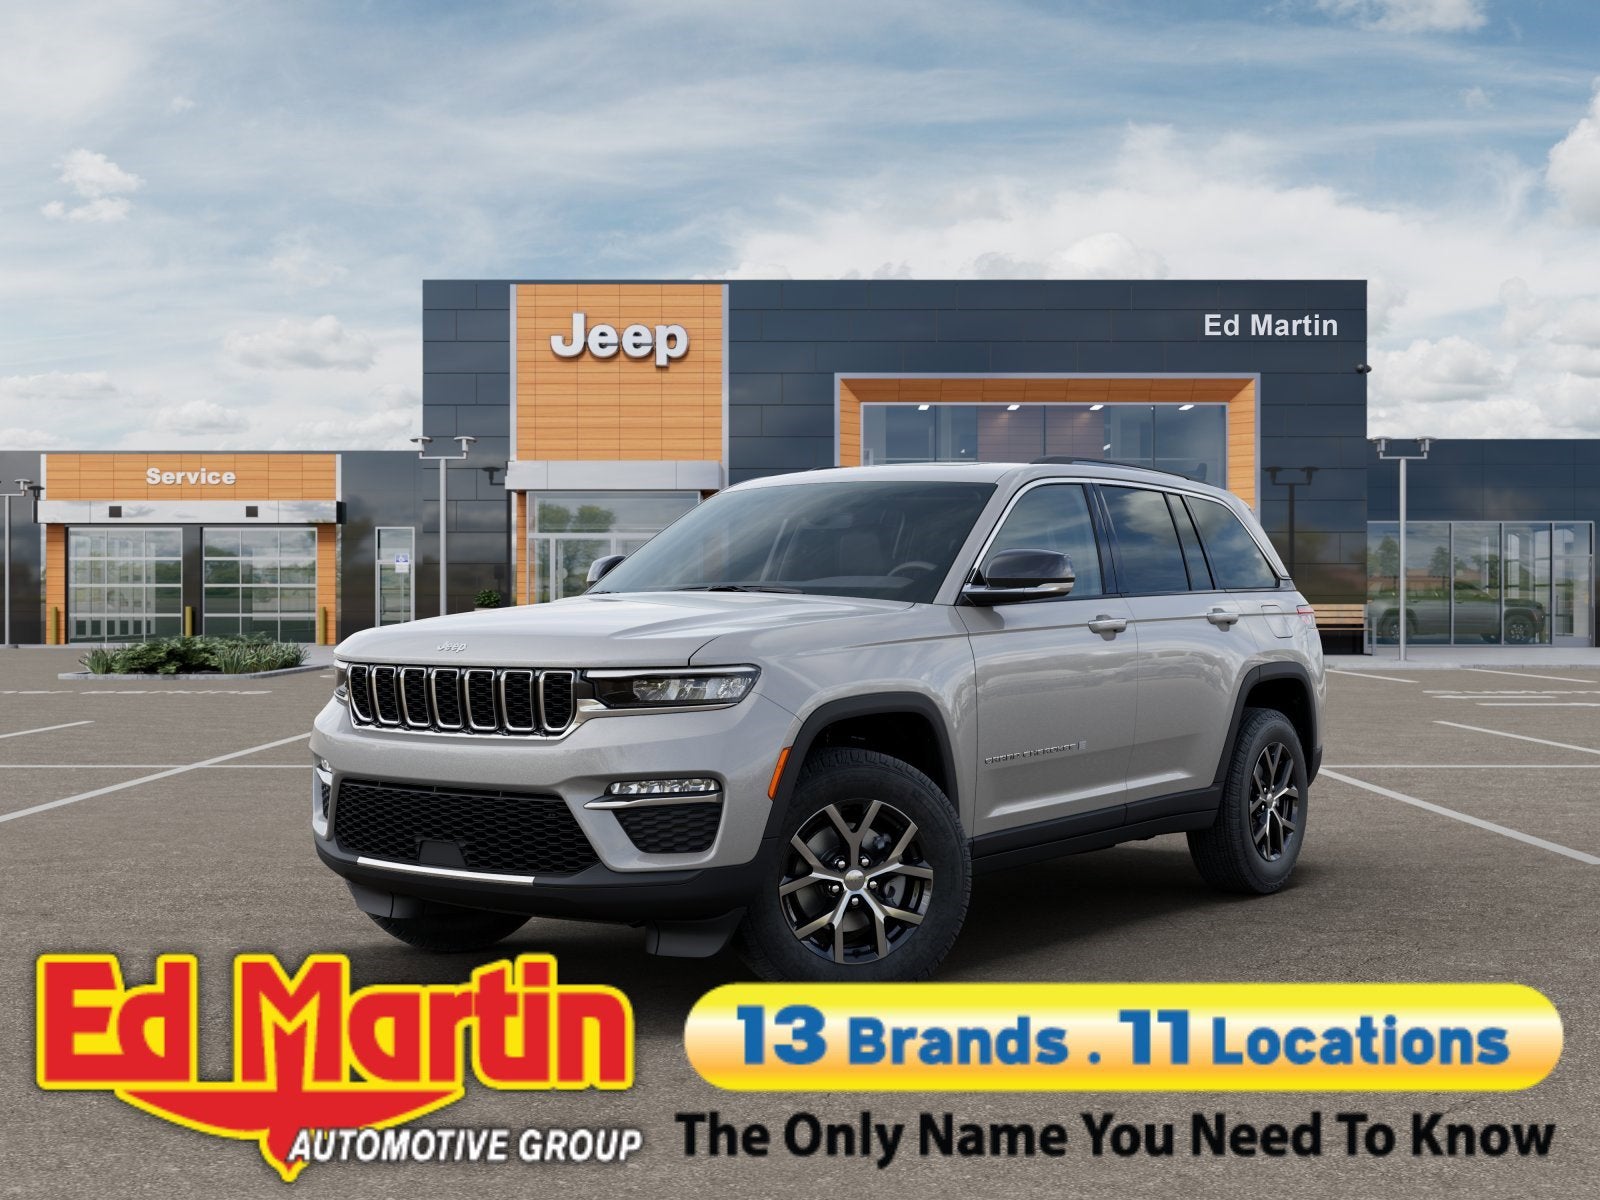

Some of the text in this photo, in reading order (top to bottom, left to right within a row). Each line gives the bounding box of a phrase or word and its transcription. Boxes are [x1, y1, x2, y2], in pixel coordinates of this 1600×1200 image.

[1204, 313, 1339, 337] Ed Martin
[550, 312, 690, 368] Jeep
[145, 467, 237, 486] Service
[437, 640, 467, 654] Jeep
